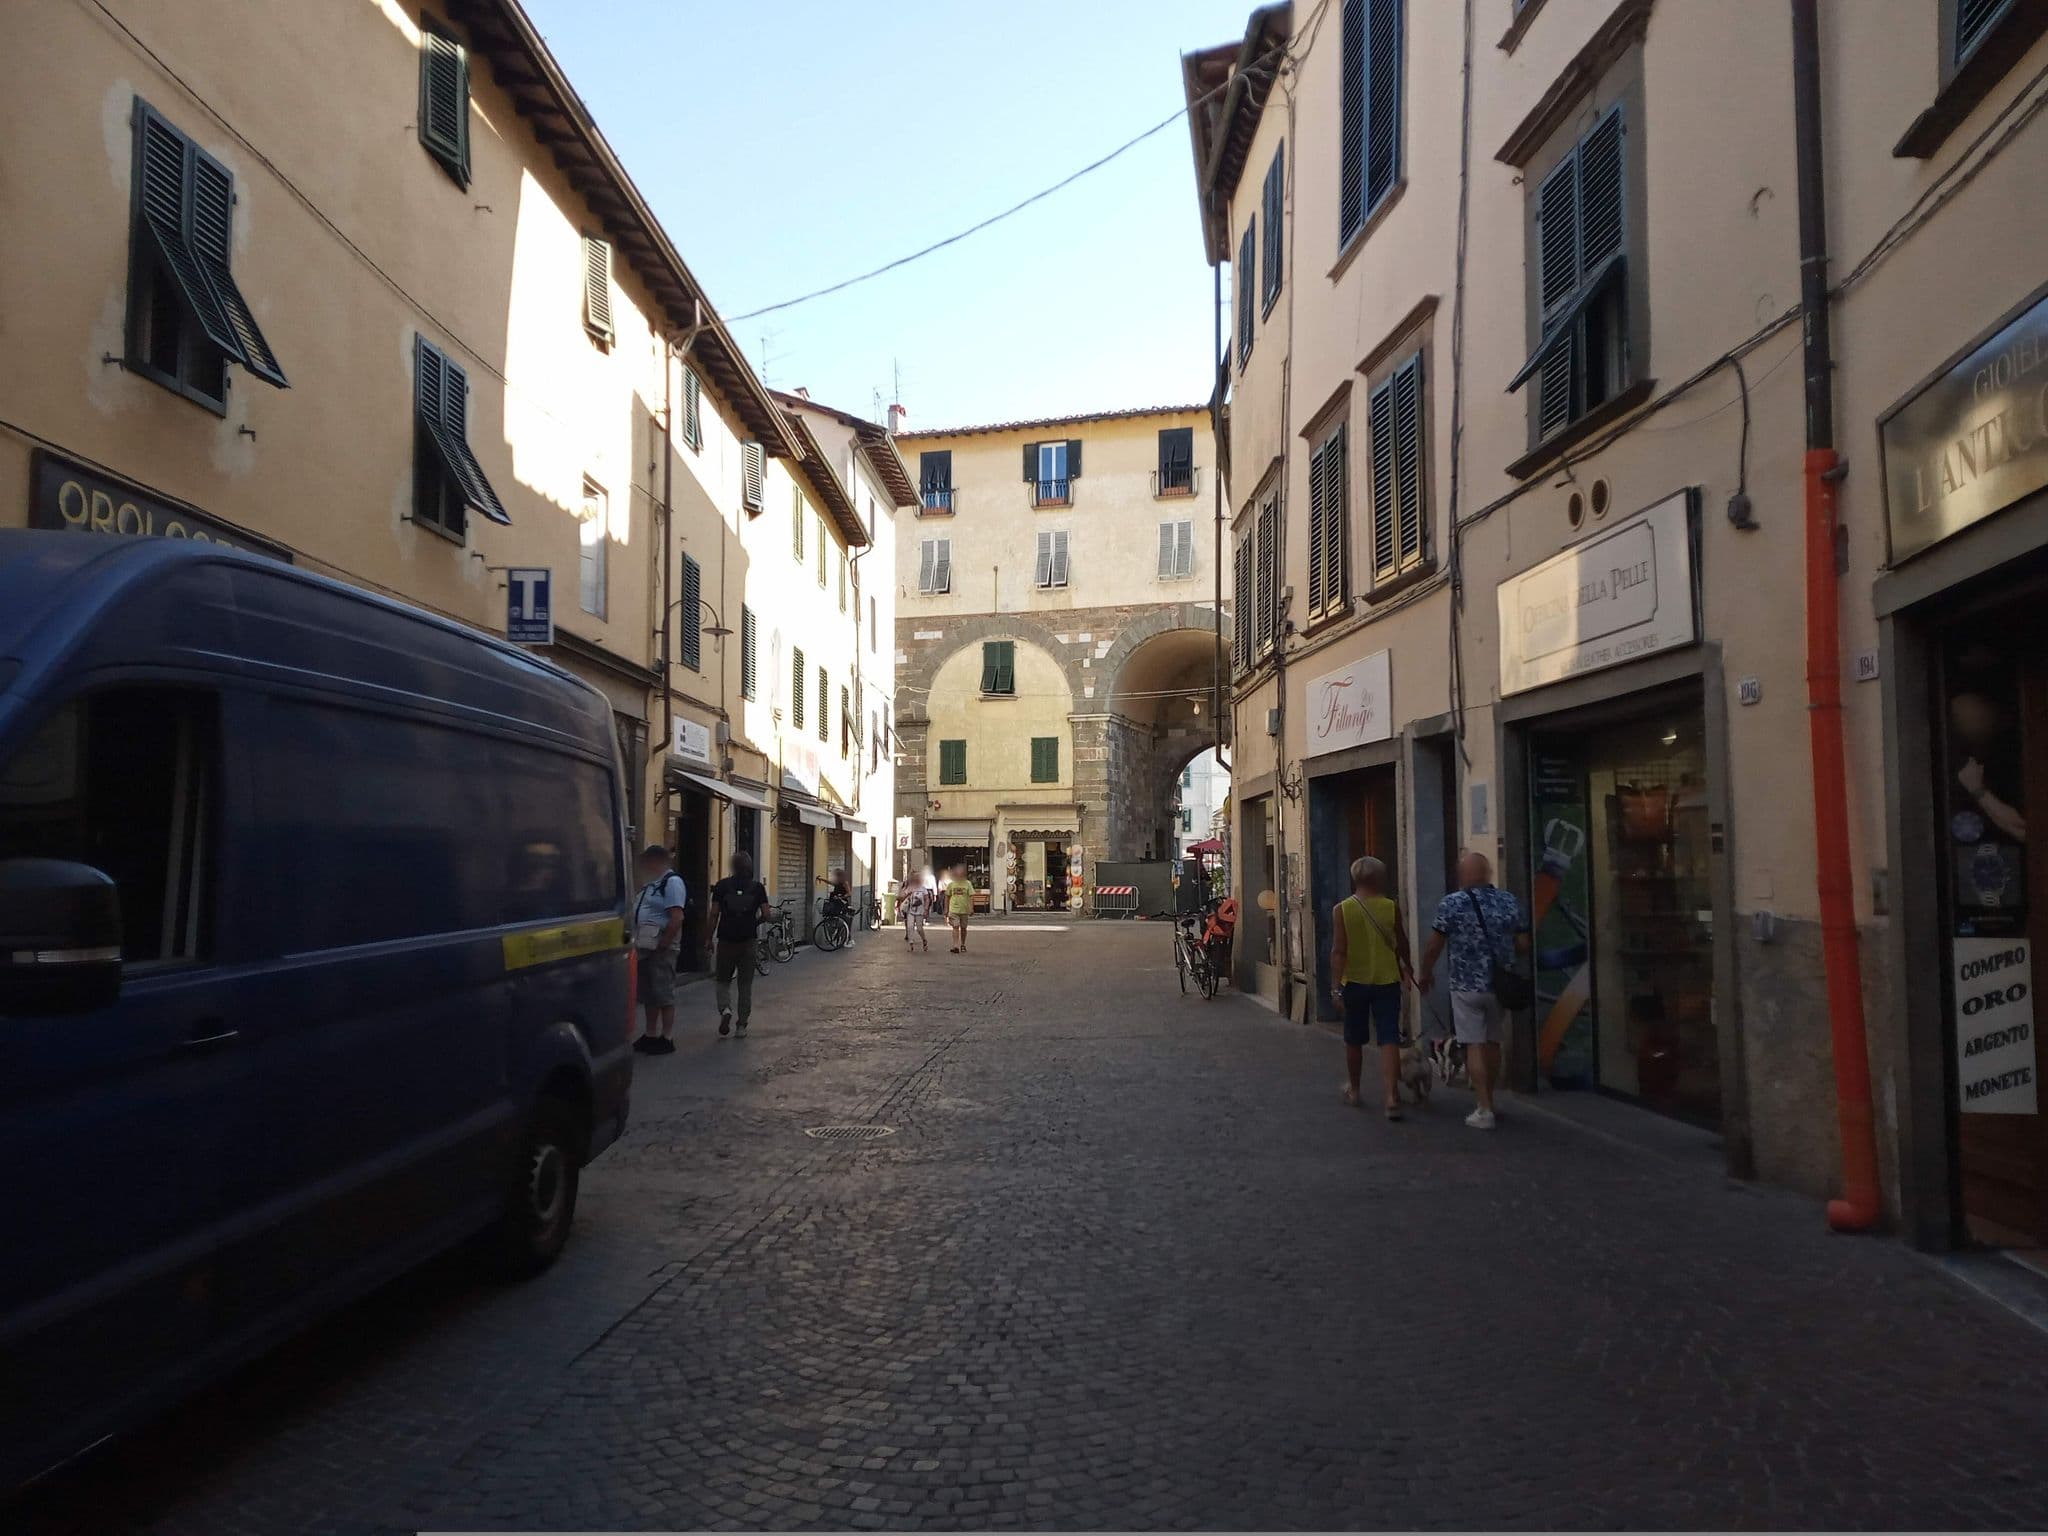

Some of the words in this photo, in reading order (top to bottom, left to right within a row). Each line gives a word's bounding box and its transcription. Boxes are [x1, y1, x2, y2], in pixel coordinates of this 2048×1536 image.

[512, 571, 547, 620] T
[1961, 946, 2026, 981] COMPRO
[1962, 983, 2027, 1016] ORO
[1964, 1023, 2029, 1058] ARGENTO
[1965, 1066, 2031, 1102] MONETE
